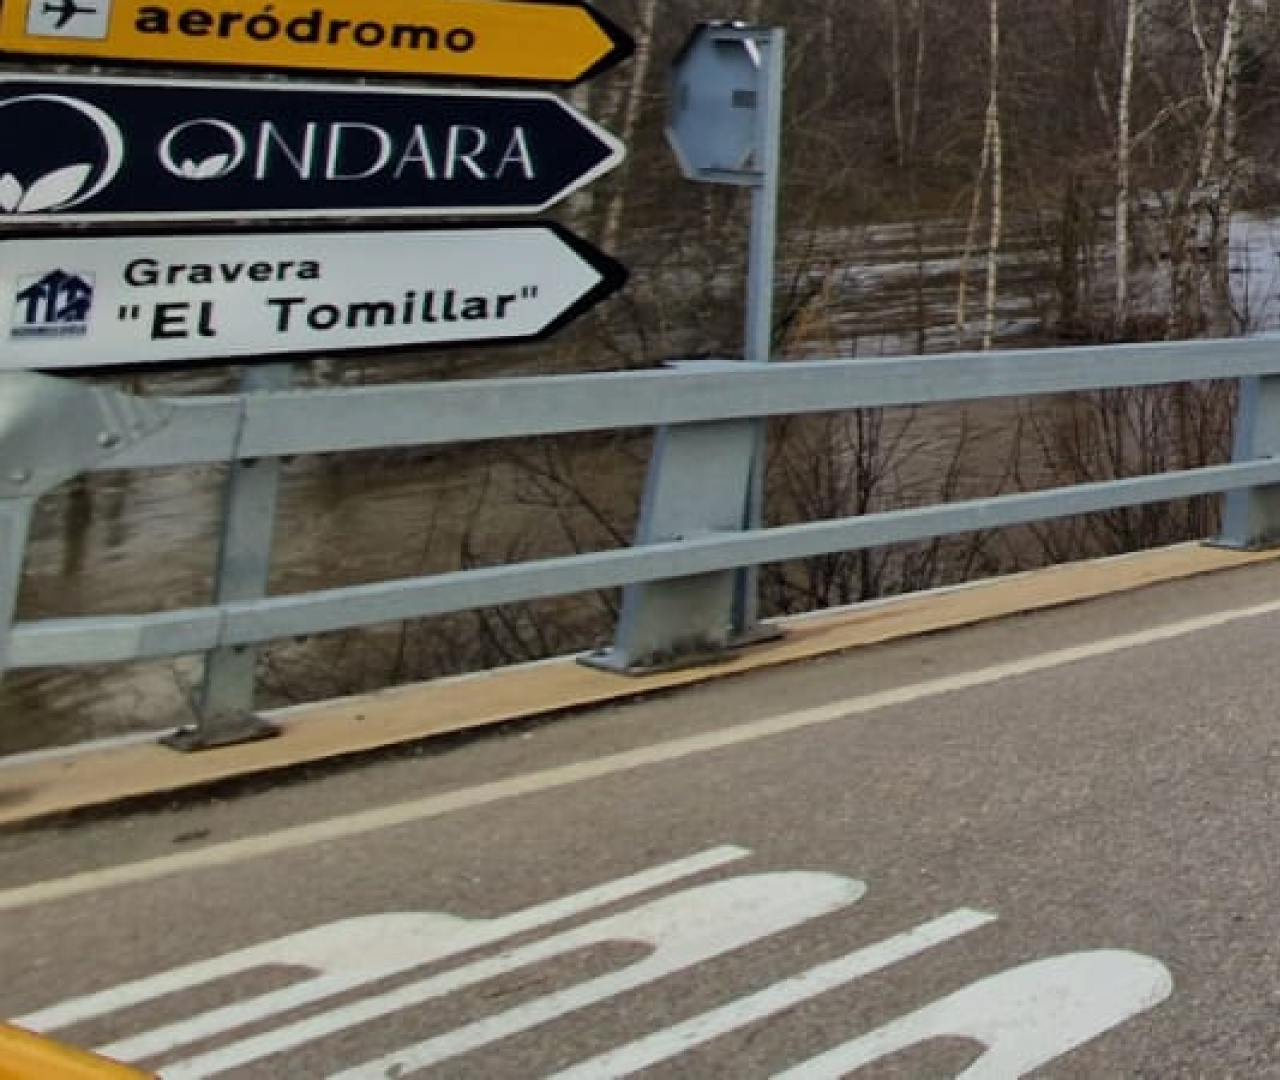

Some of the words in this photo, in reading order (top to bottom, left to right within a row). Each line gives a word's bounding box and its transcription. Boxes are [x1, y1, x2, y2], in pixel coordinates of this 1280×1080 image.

[135, 4, 475, 54] aeródromo
[124, 258, 320, 287] Gravera
[118, 301, 215, 341] "El
[268, 286, 540, 334] Tomillar"
